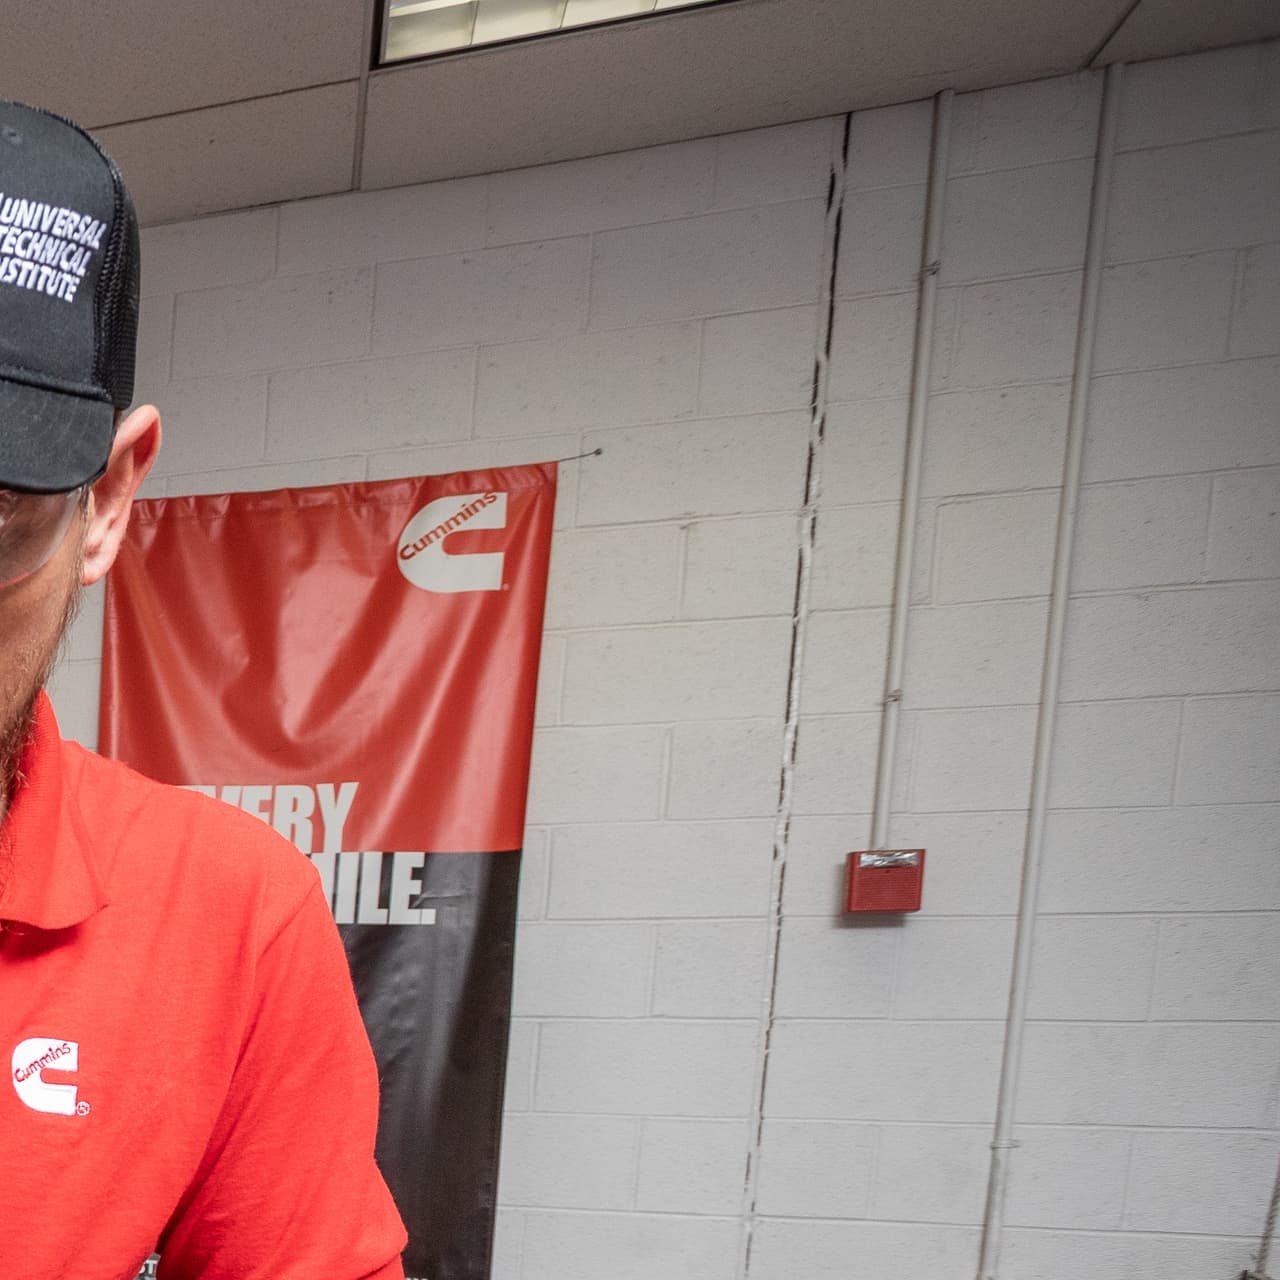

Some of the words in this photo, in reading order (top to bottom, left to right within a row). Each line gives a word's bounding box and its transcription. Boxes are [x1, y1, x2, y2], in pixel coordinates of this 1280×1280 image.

[0, 197, 107, 249] UNIVERSAL
[399, 491, 498, 560] Cummins
[14, 1043, 71, 1082] Cummins
